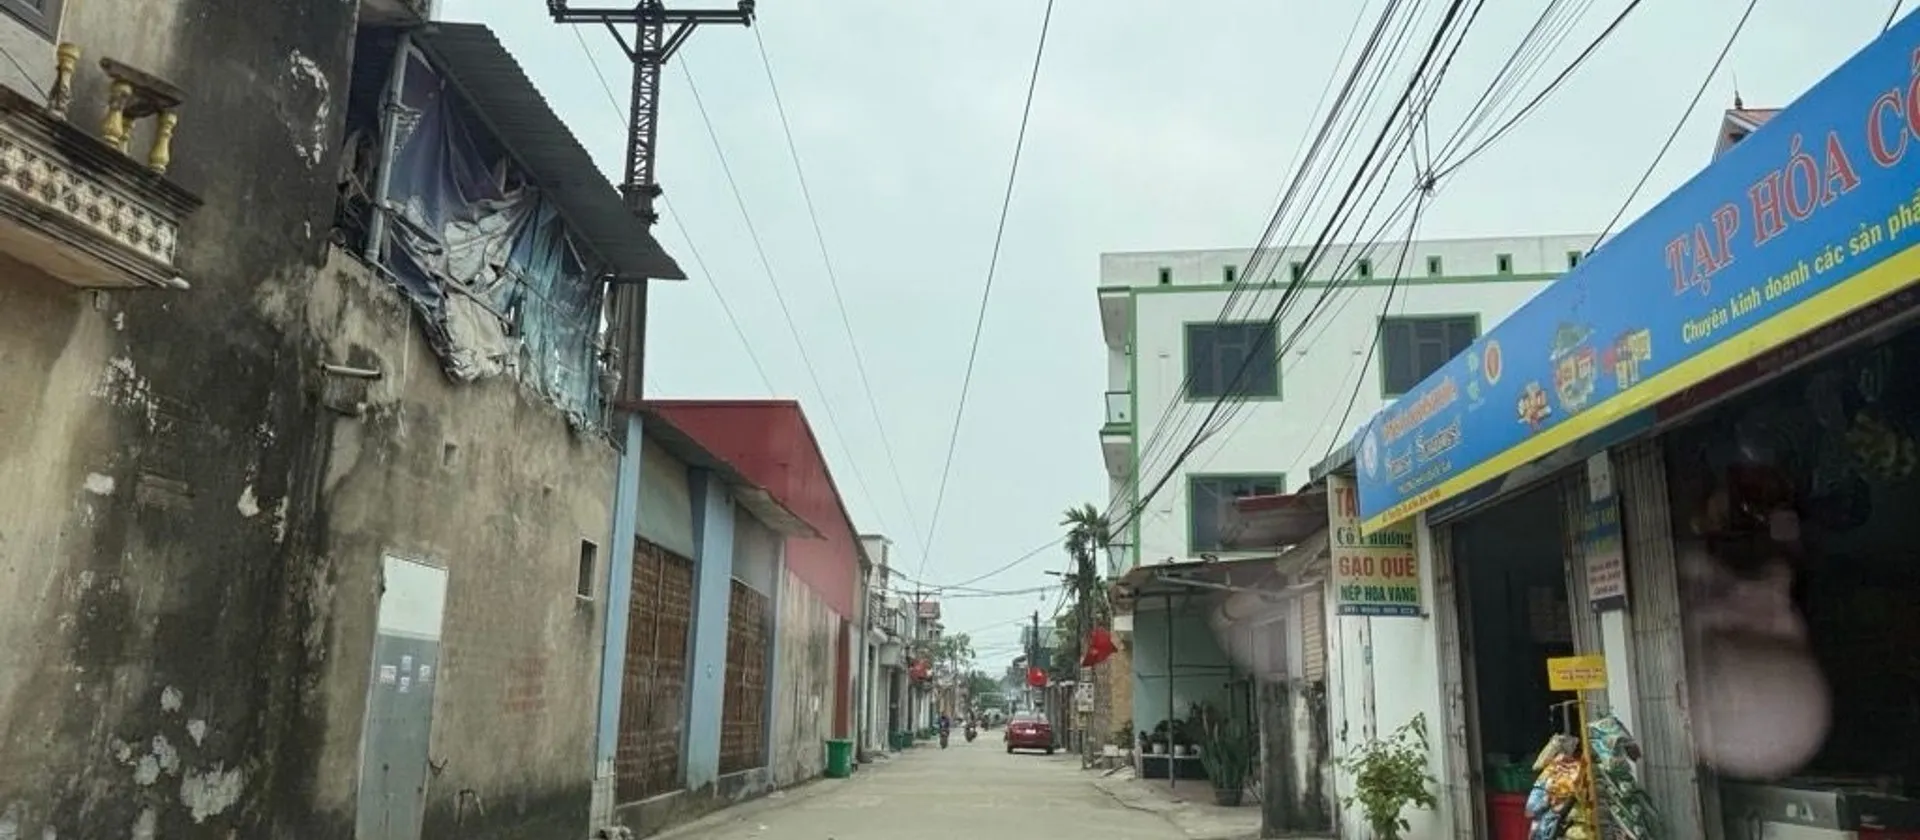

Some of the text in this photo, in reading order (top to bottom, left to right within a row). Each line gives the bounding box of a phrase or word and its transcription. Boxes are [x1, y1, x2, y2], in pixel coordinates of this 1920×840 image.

[1665, 203, 1740, 296] TẠP
[1750, 130, 1861, 247] HÓA
[1683, 307, 1728, 344] Chuyên
[1732, 287, 1761, 320] kinh
[1765, 259, 1810, 300] doanh
[1814, 243, 1845, 275] các
[1335, 488, 1357, 523] TẠ
[1339, 553, 1415, 580] GẠO QUÊ
